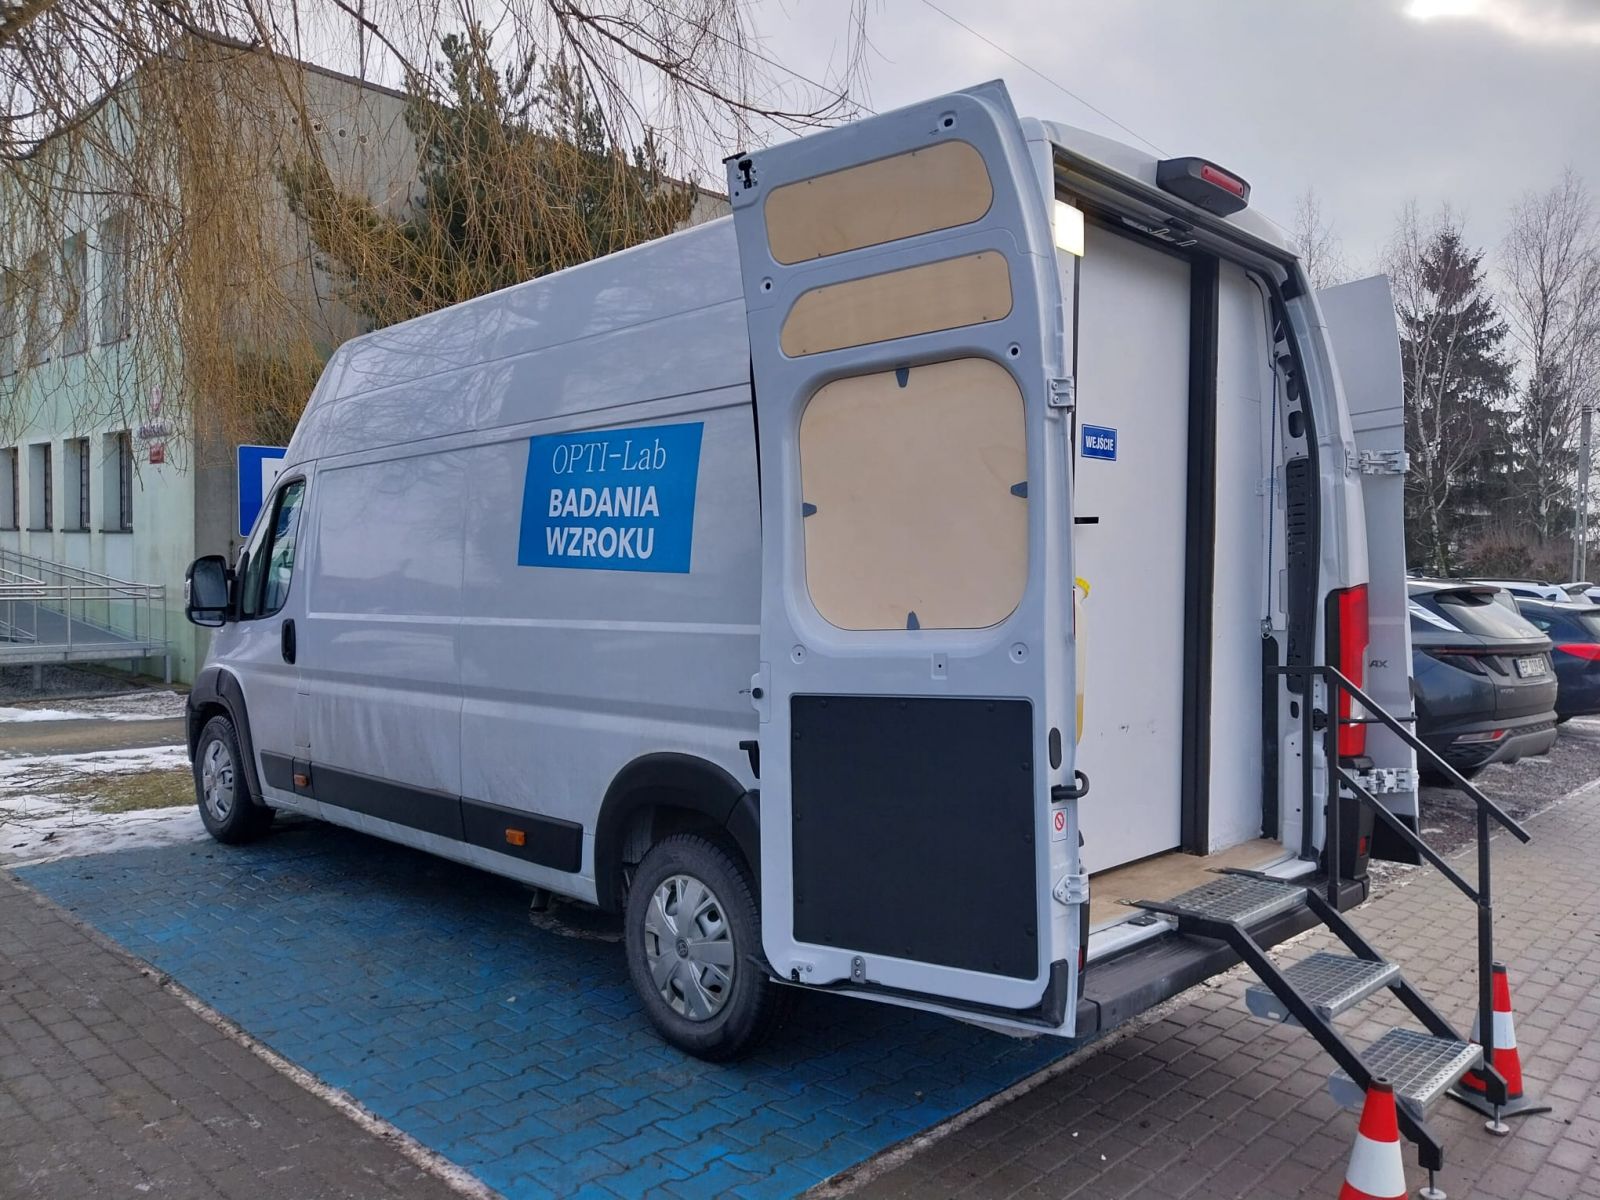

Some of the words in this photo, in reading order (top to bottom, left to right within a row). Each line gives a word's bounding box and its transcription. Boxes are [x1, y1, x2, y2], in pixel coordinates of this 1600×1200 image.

[552, 438, 667, 475] OPTI-Lab
[1085, 434, 1114, 451] WEJŚCIE
[548, 485, 660, 518] BADANIA
[545, 526, 655, 560] WZROKU
